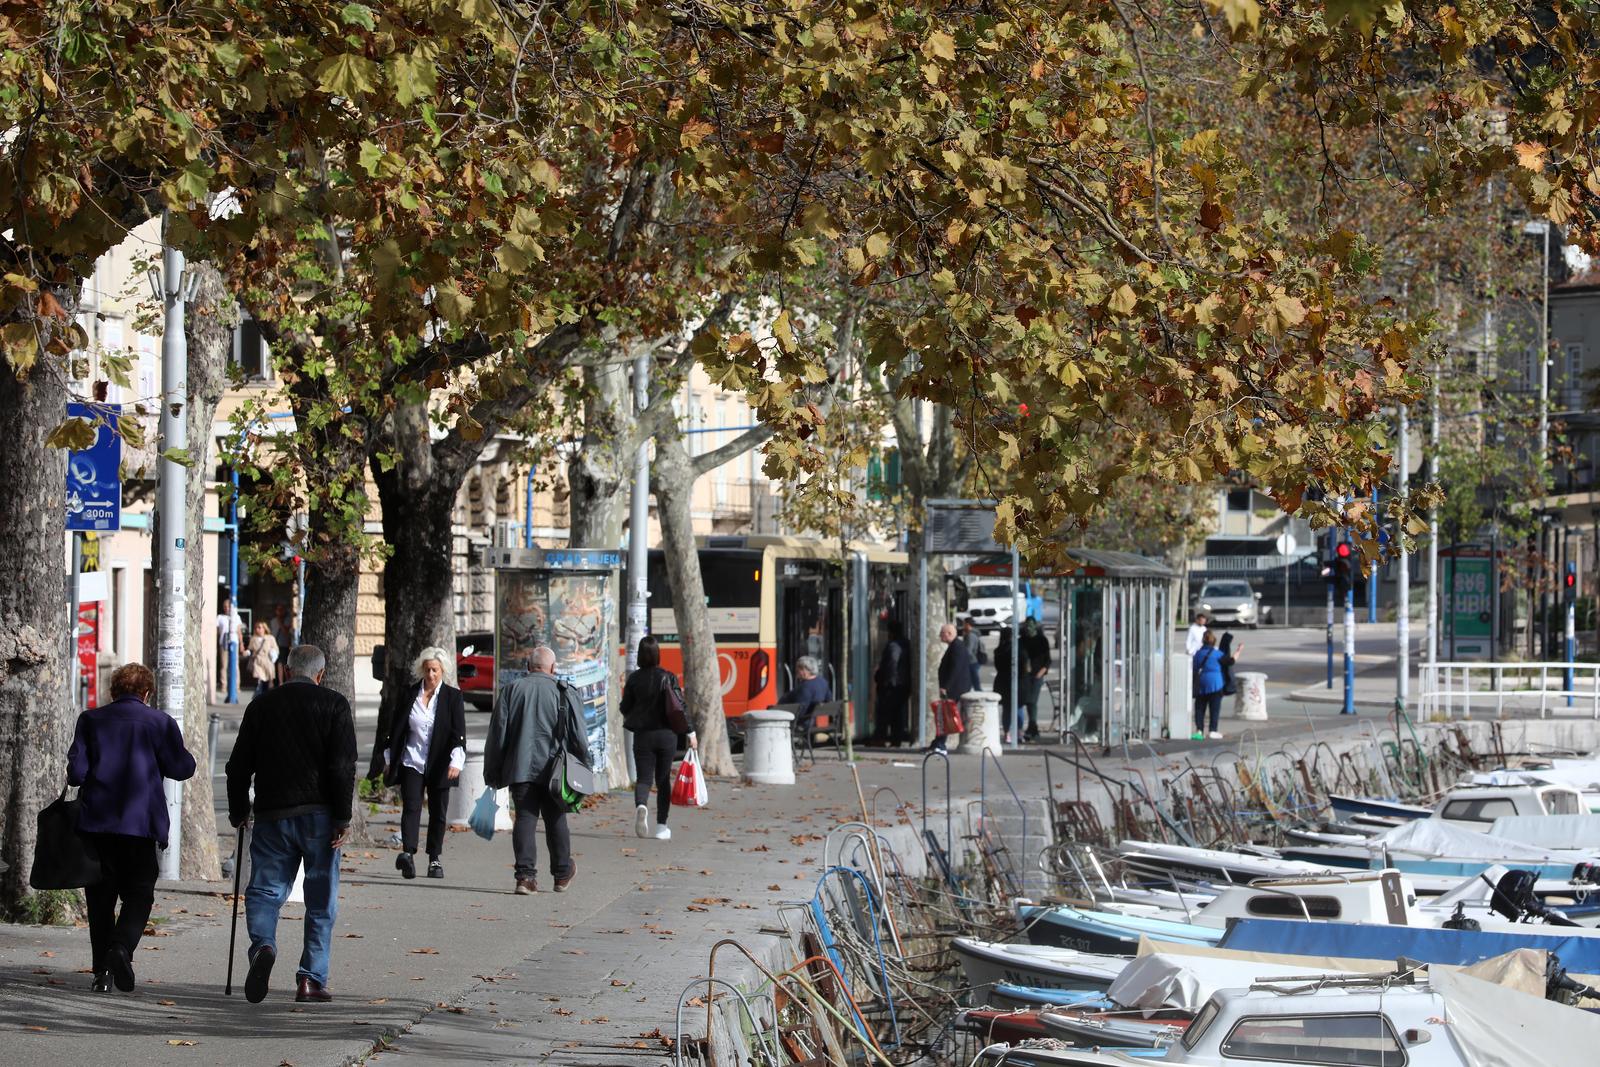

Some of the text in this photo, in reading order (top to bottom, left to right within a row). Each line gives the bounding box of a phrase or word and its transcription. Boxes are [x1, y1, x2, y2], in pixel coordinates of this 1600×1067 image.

[86, 509, 114, 518] 300m
[546, 552, 582, 565] GRAD
[734, 651, 750, 660] 793
